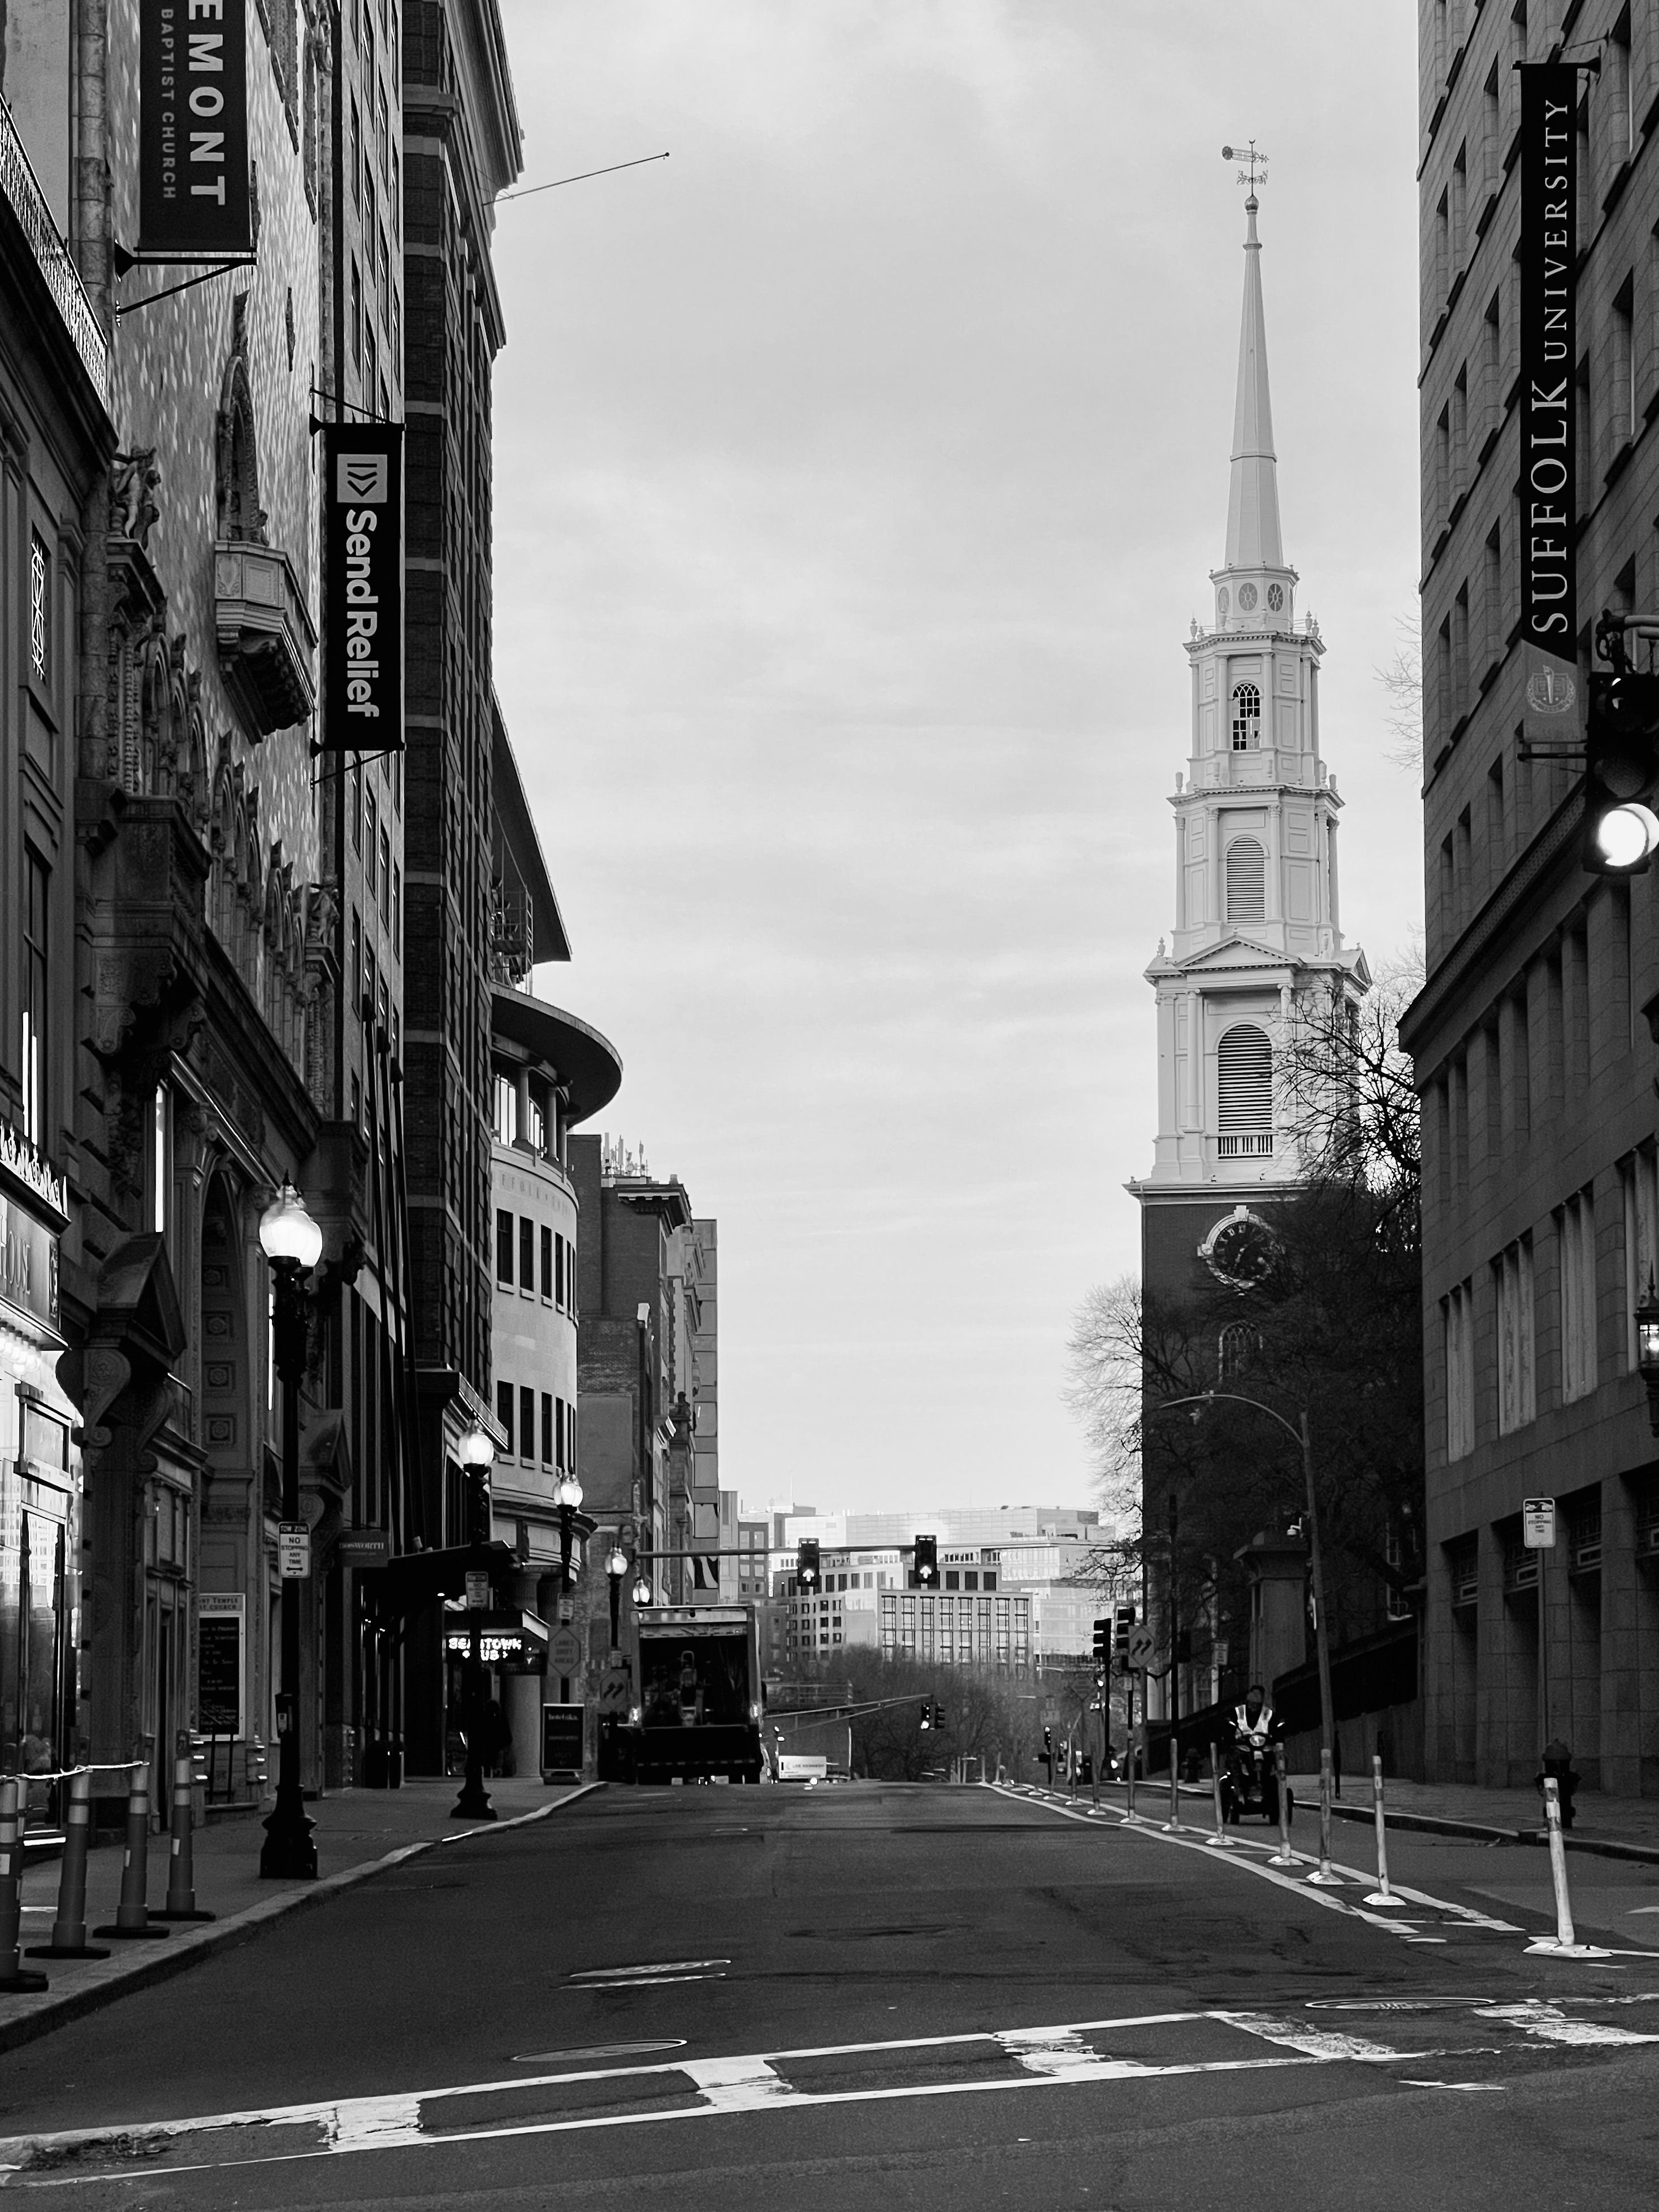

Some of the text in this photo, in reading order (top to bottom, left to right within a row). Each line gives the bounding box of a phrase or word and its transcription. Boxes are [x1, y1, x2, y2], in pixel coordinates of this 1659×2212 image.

[161, 8, 176, 198] BAPTIST CHURCH
[1531, 99, 1569, 633] SUFFOLK UNIVERSITY
[346, 509, 380, 717] Send Relief
